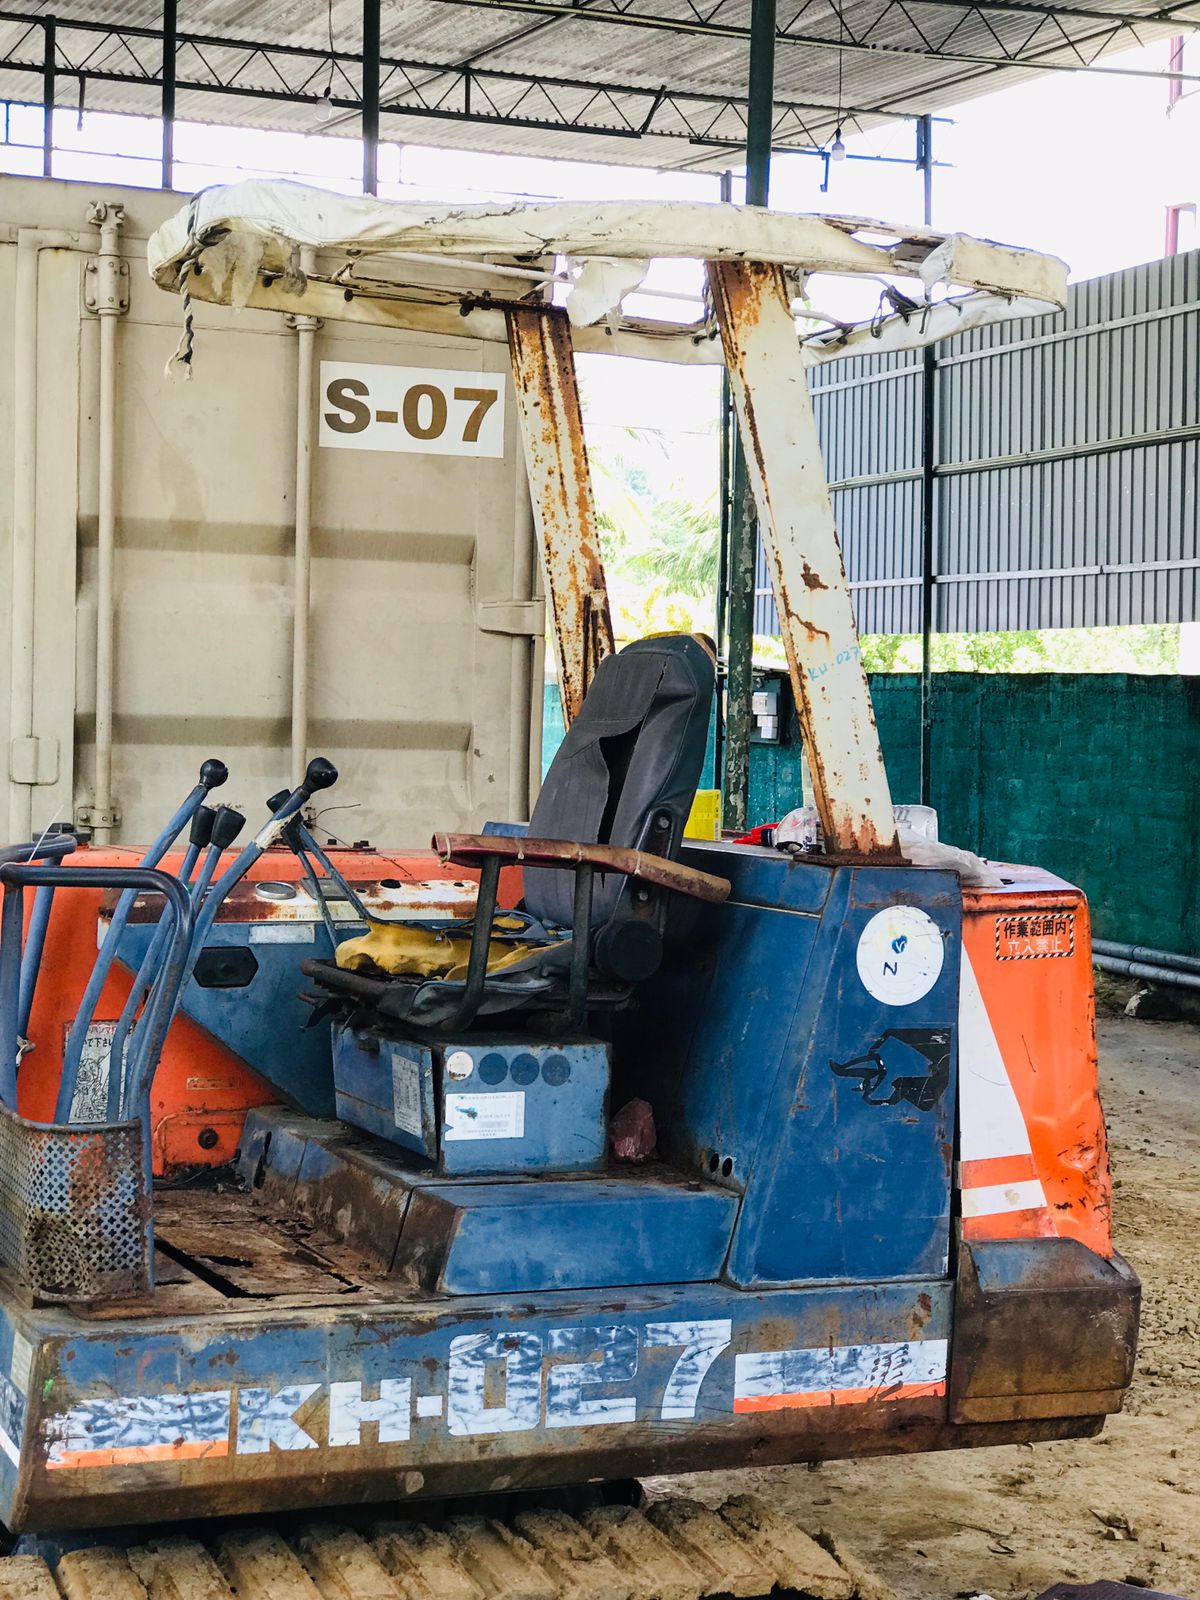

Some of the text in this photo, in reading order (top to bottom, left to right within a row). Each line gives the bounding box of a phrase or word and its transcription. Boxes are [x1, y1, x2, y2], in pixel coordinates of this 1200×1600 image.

[324, 378, 498, 442] S-07
[1004, 920, 1067, 939] 作業範囲内
[1007, 937, 1064, 956] 立入禁止
[236, 1318, 733, 1455] KH-027
